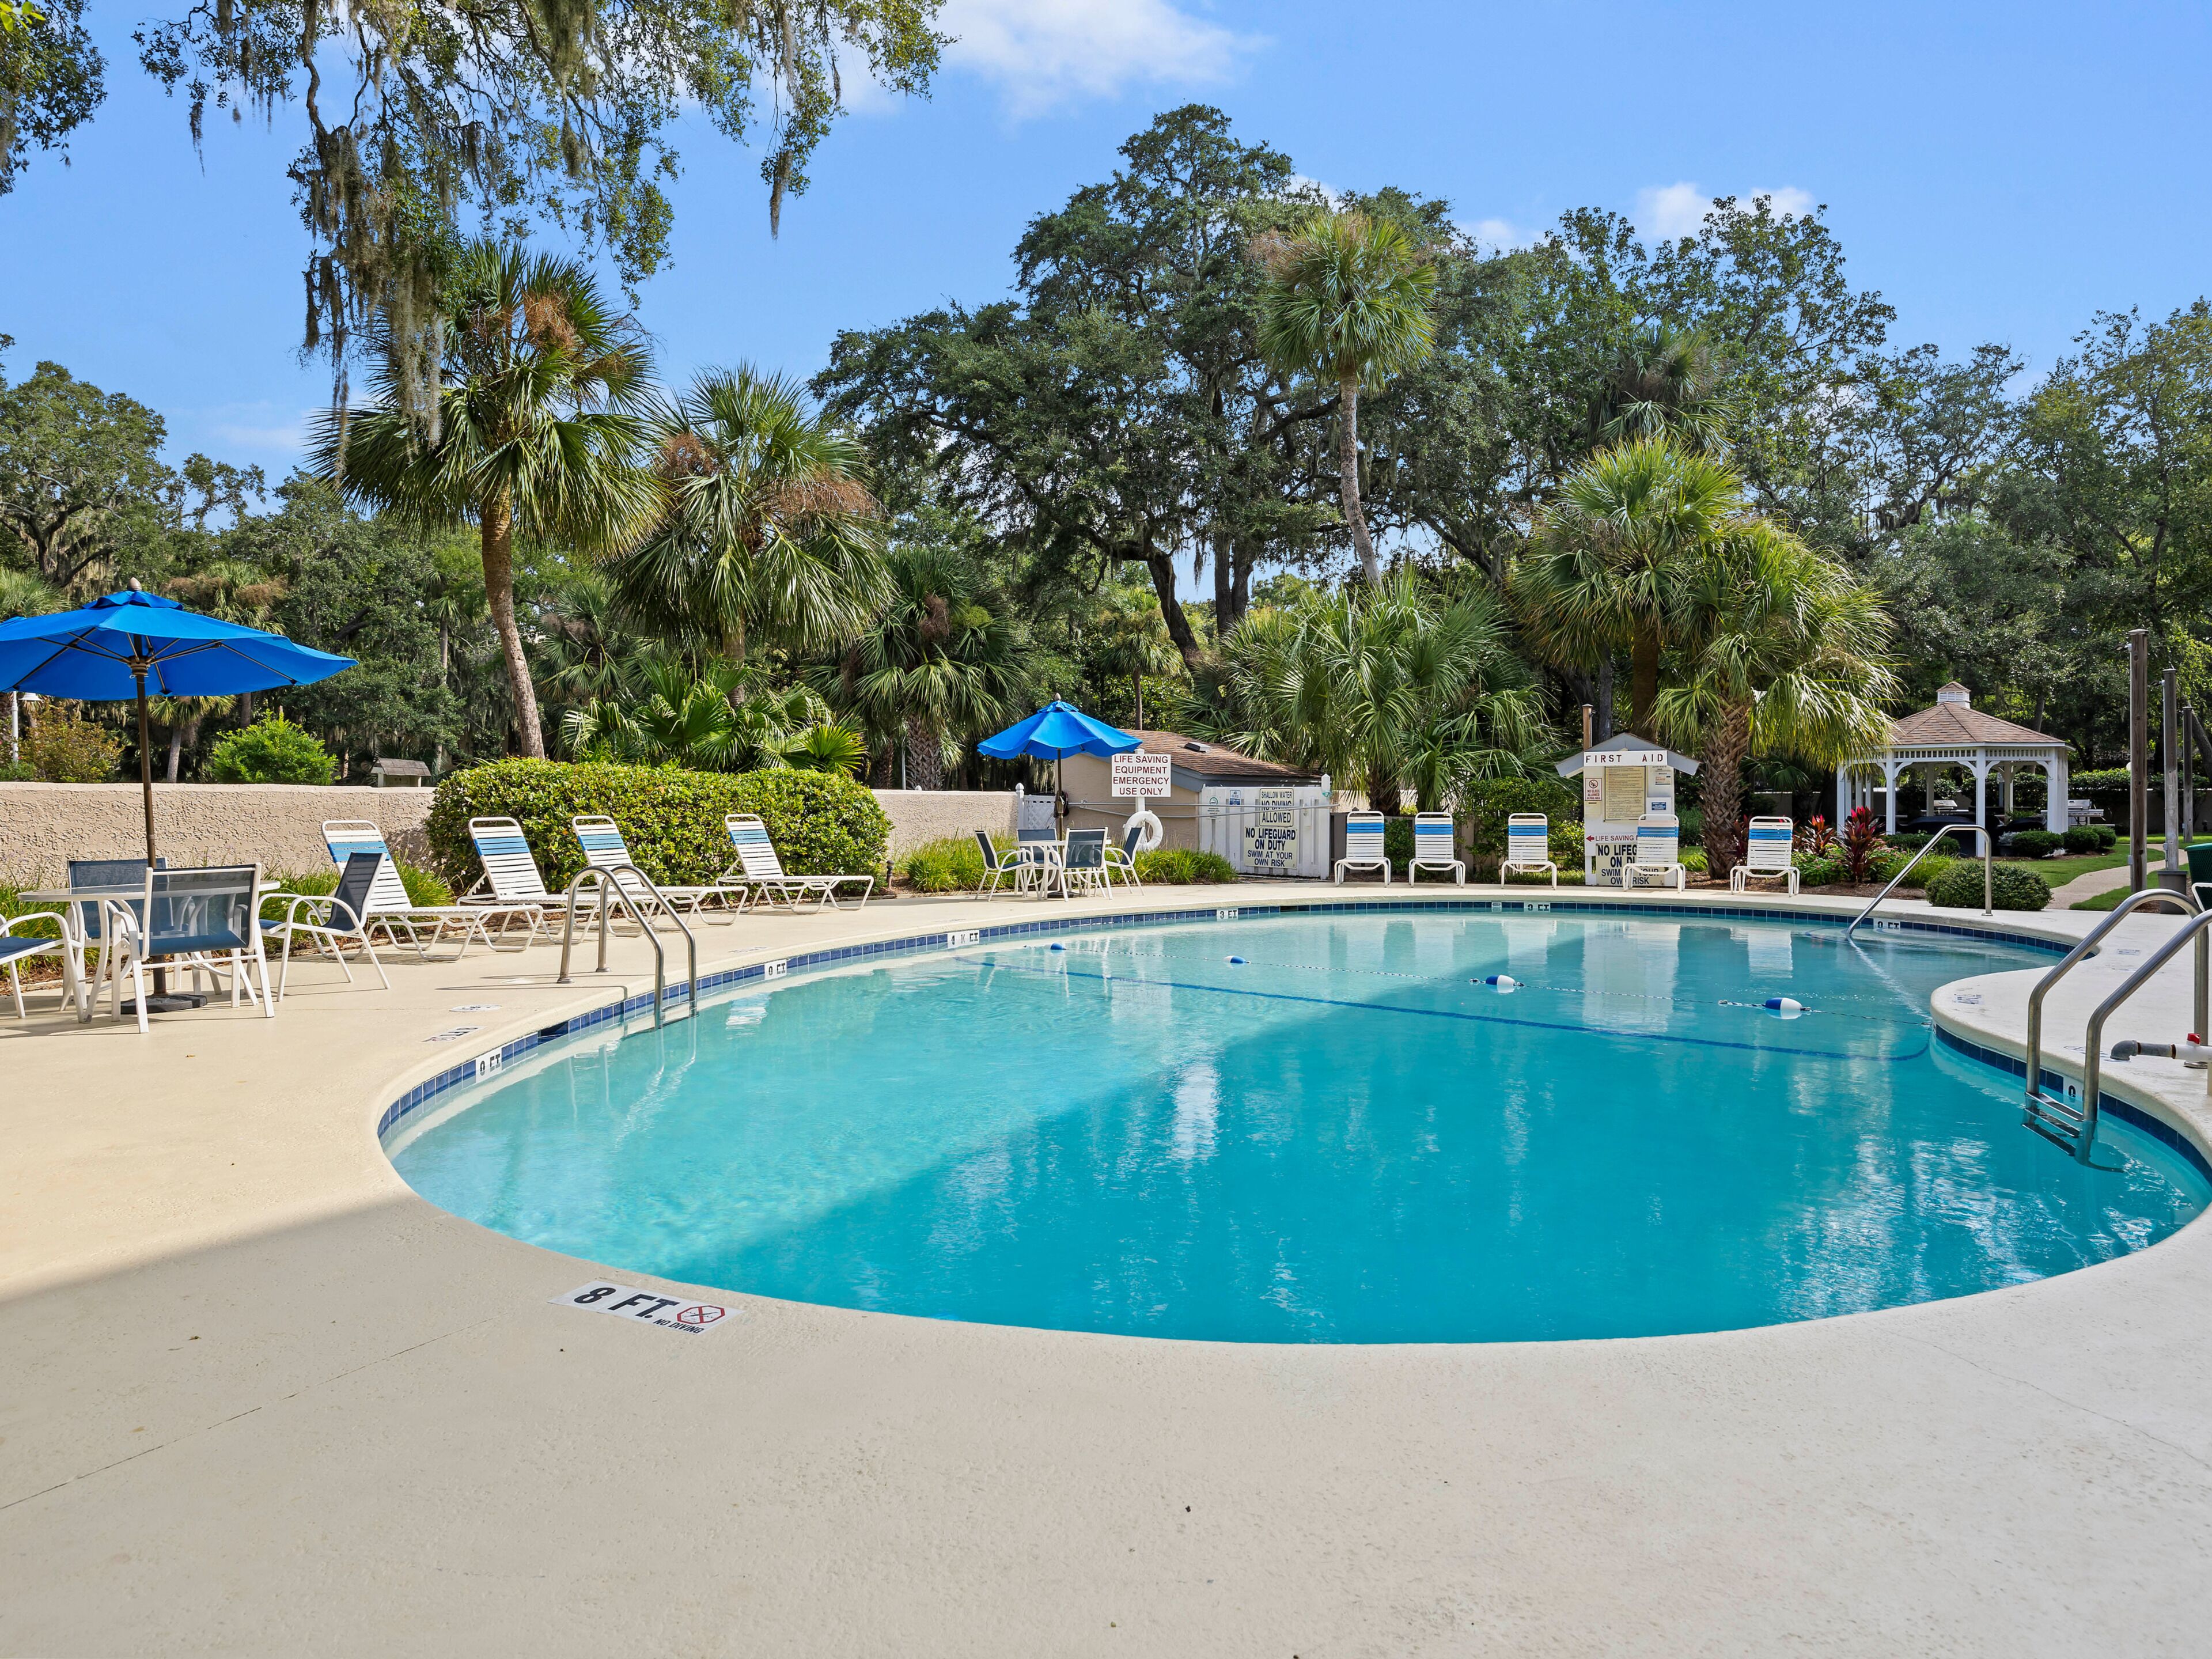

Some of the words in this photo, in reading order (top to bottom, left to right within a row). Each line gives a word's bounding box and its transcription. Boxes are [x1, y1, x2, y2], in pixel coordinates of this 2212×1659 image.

[1135, 755, 1168, 764] SAVING
[1586, 755, 1622, 763] FIRST
[1642, 754, 1664, 762] AID
[1115, 766, 1167, 774] EQUIPMENT
[1113, 777, 1169, 785] EMERGENCY
[1139, 787, 1163, 796] ONLY
[1279, 791, 1292, 799] WATER
[1262, 800, 1270, 811] NO
[1271, 800, 1292, 811] DIVING
[1262, 812, 1291, 823] ALLOWED
[1245, 827, 1255, 838] NO
[1258, 828, 1296, 840] LIFEGUARD
[1255, 839, 1264, 850] ON
[1267, 840, 1286, 851] DUTY
[1597, 844, 1610, 856] NO
[1614, 844, 1637, 856] LIFEG
[1247, 850, 1263, 858] SWIM
[1277, 851, 1293, 860] YOUR
[1254, 858, 1268, 866] OWN
[1271, 859, 1285, 867] RISK
[1610, 856, 1622, 868] ON
[1601, 869, 1620, 877] SWIM
[1611, 877, 1623, 885] OW
[1633, 877, 1650, 885] RISK
[574, 1287, 616, 1304] 8
[653, 1318, 671, 1326] NO
[668, 1322, 705, 1334] DIVING
